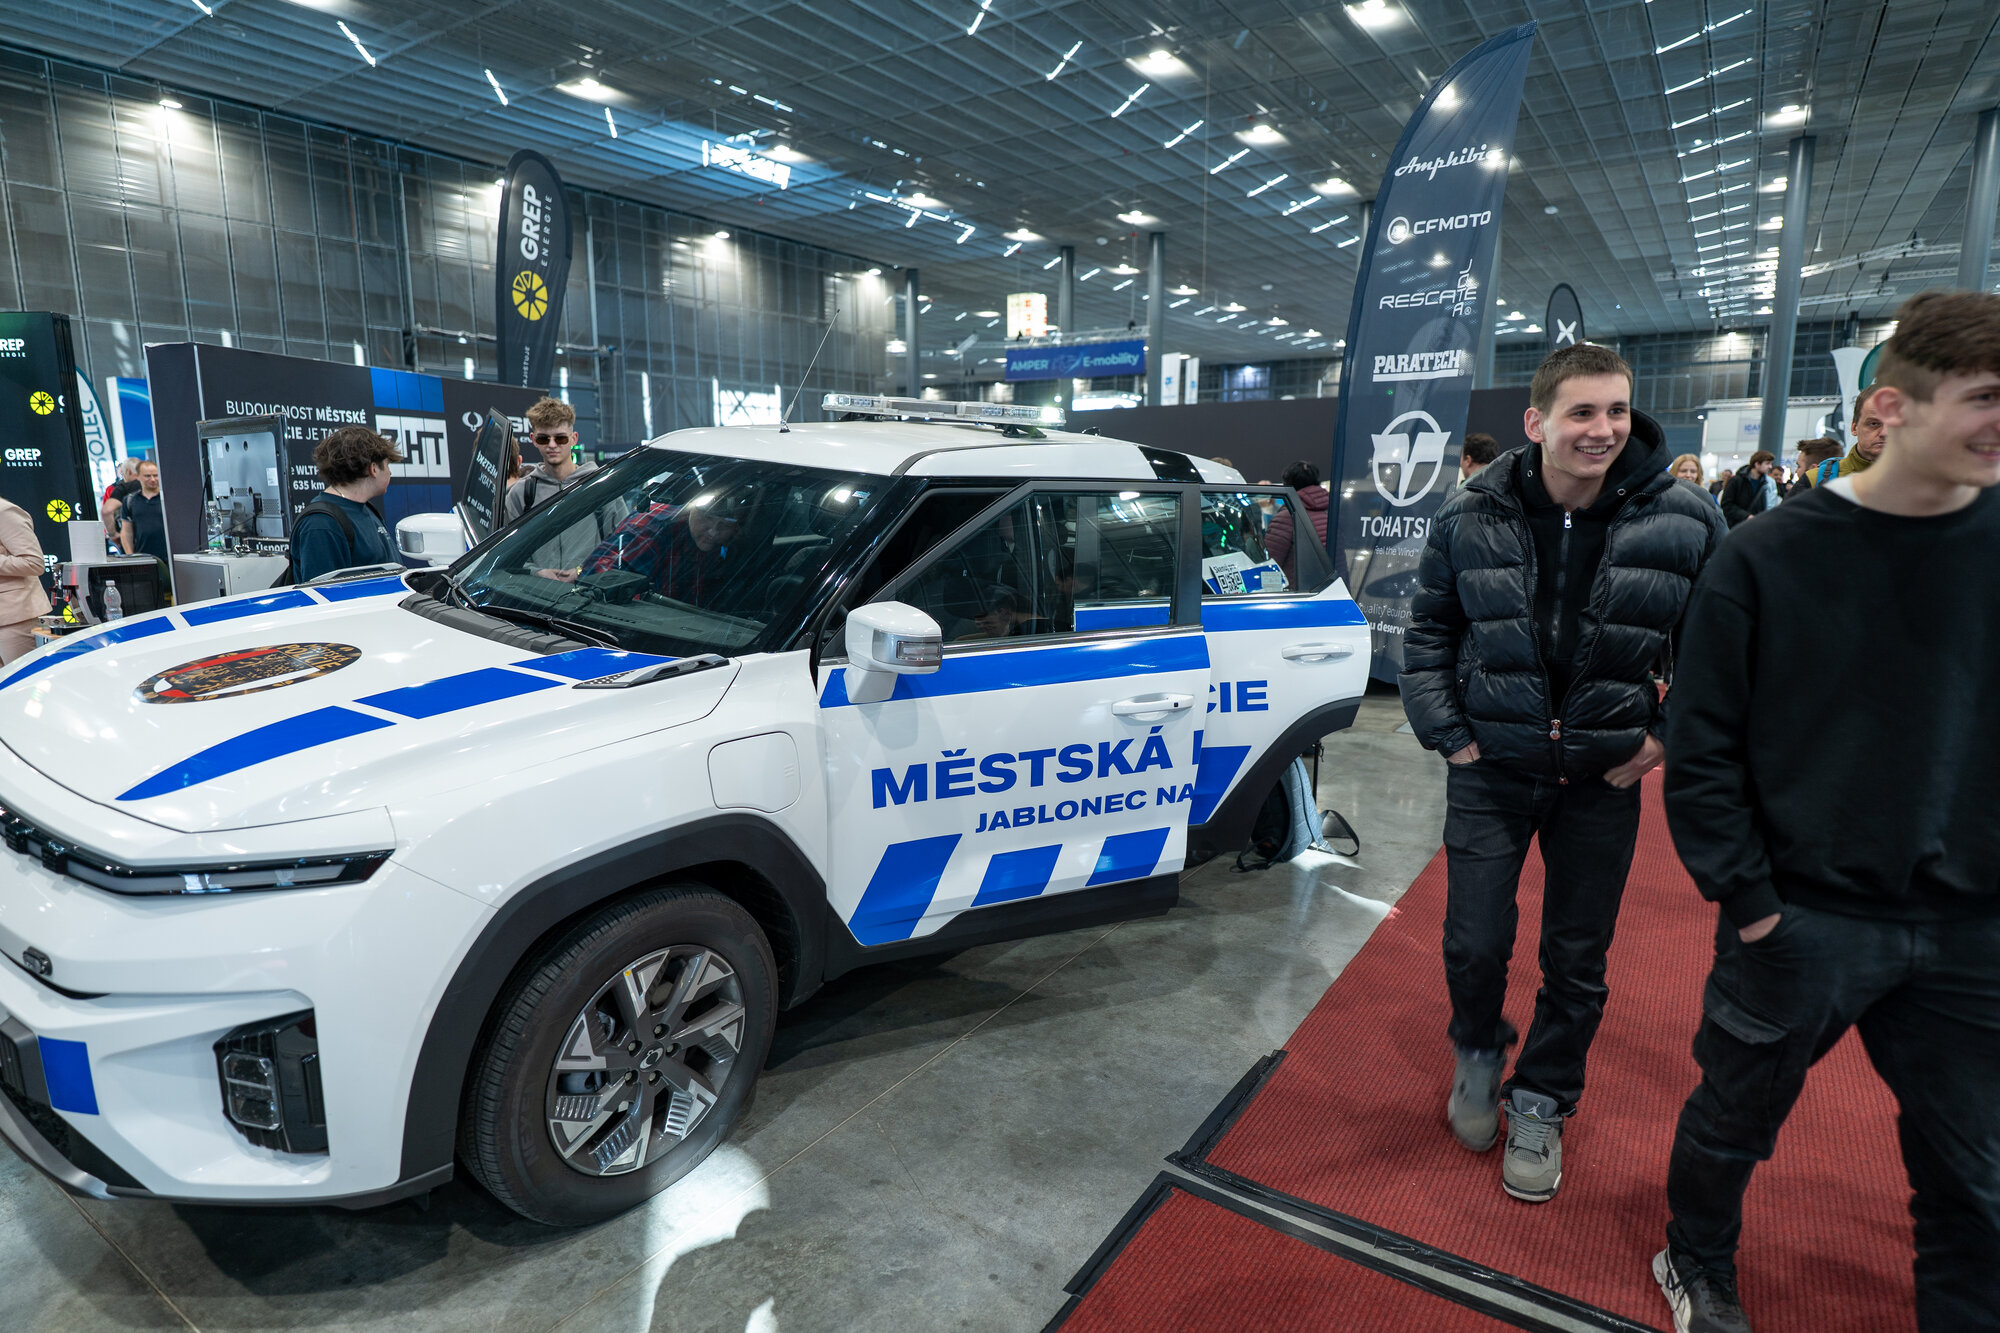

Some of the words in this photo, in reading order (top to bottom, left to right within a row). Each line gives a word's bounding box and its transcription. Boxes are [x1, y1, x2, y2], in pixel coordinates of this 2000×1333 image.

[520, 184, 542, 261] GREP
[541, 194, 553, 267] ENERGIE
[1413, 210, 1492, 235] CFMOTO
[1010, 359, 1048, 371] AMPER
[1083, 351, 1140, 368] E-mobility
[1373, 349, 1462, 374] PARATECH
[226, 400, 314, 420] BUDOUCNOST
[316, 406, 367, 424] MĚSTSKÉ
[306, 427, 319, 441] JE
[4, 448, 41, 460] GREP
[293, 480, 309, 490] 635
[311, 480, 325, 490] km
[871, 725, 1174, 810] MĚSTSKÁ
[975, 790, 1147, 834] JABLONEC
[1156, 783, 1194, 806] NA
